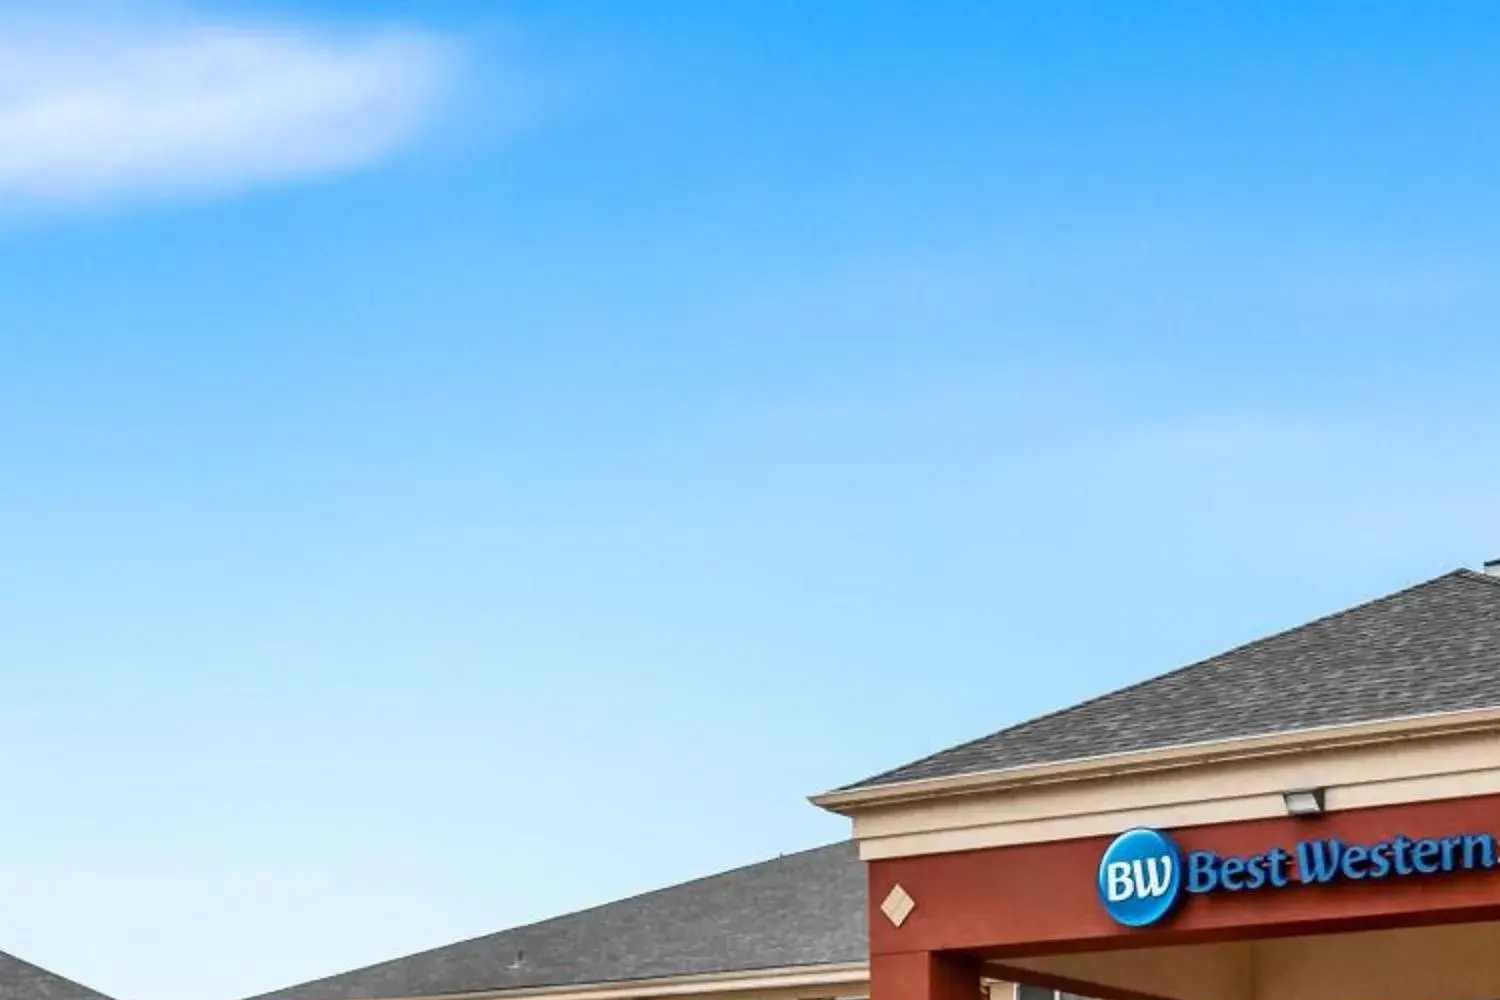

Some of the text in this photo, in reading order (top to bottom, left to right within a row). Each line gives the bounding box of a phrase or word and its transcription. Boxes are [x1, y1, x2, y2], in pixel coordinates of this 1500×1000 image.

[1107, 855, 1173, 902] BW
[1187, 831, 1500, 894] Best Western
